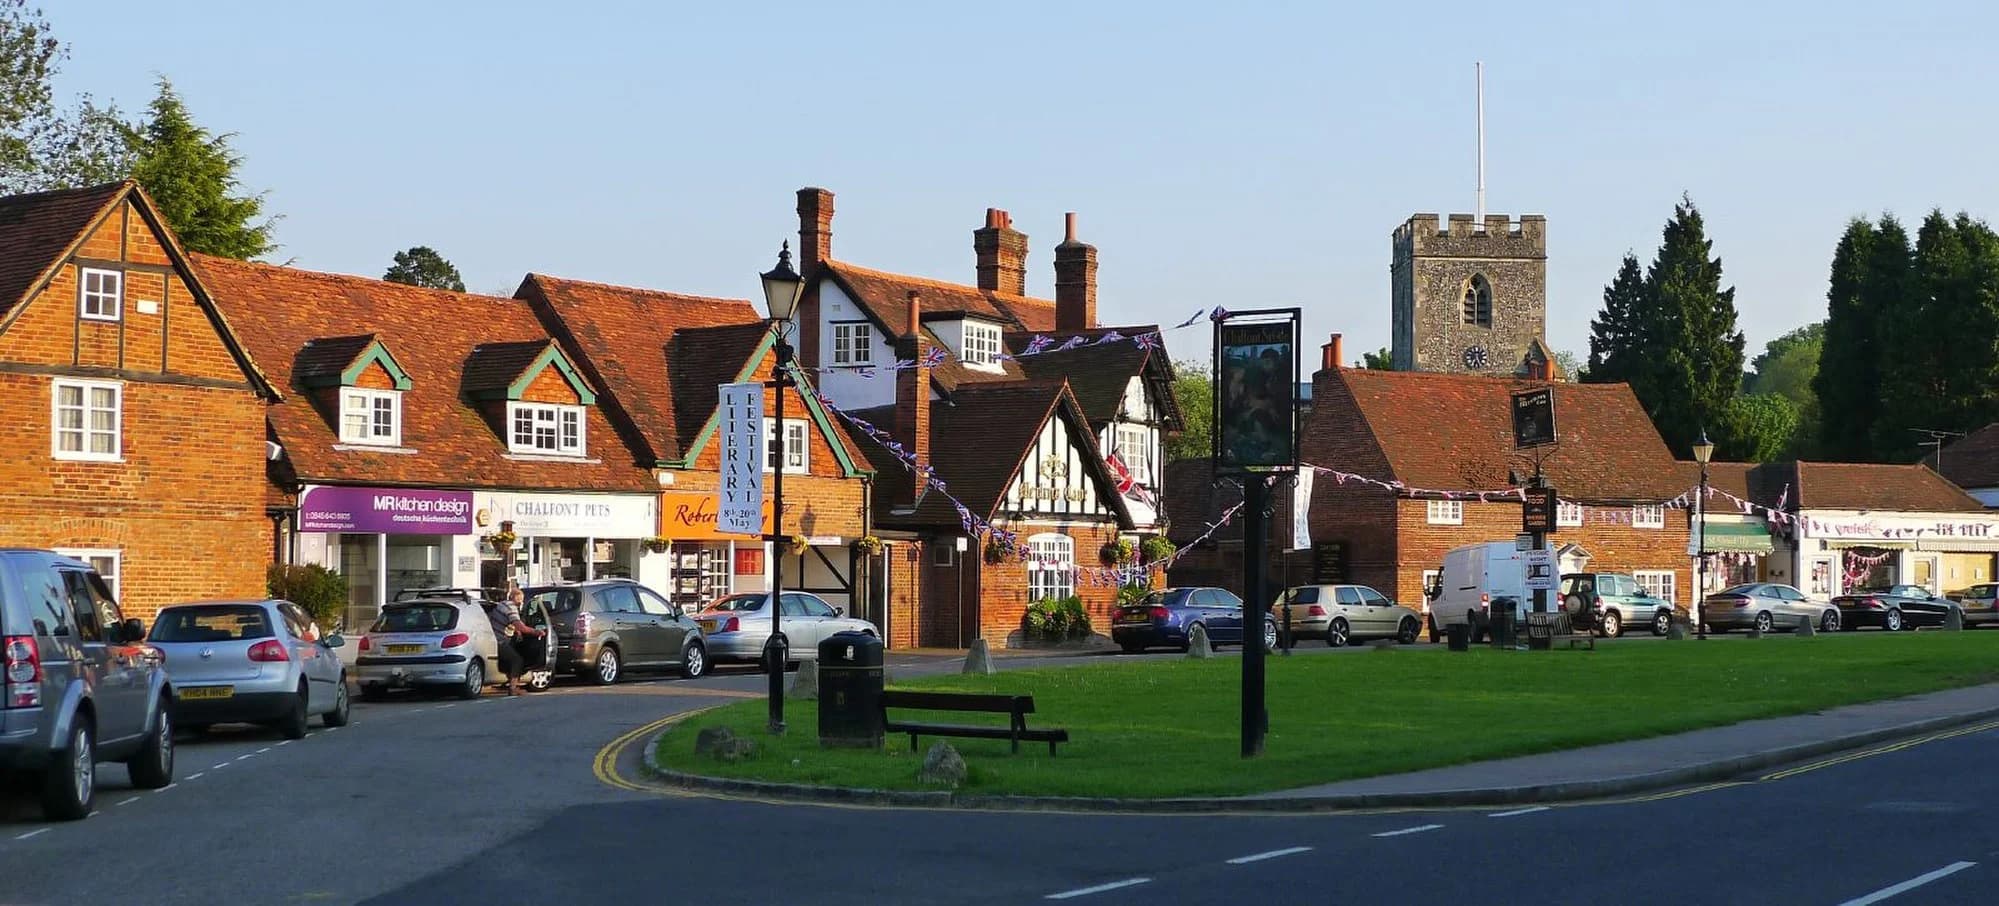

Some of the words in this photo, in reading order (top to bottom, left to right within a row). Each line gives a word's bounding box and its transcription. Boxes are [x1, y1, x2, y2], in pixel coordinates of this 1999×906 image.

[726, 393, 738, 503] LITERARY
[746, 393, 757, 503] FESTIVAL
[516, 501, 579, 516] CHALFONT
[585, 503, 611, 517] PETS
[729, 518, 750, 530] May
